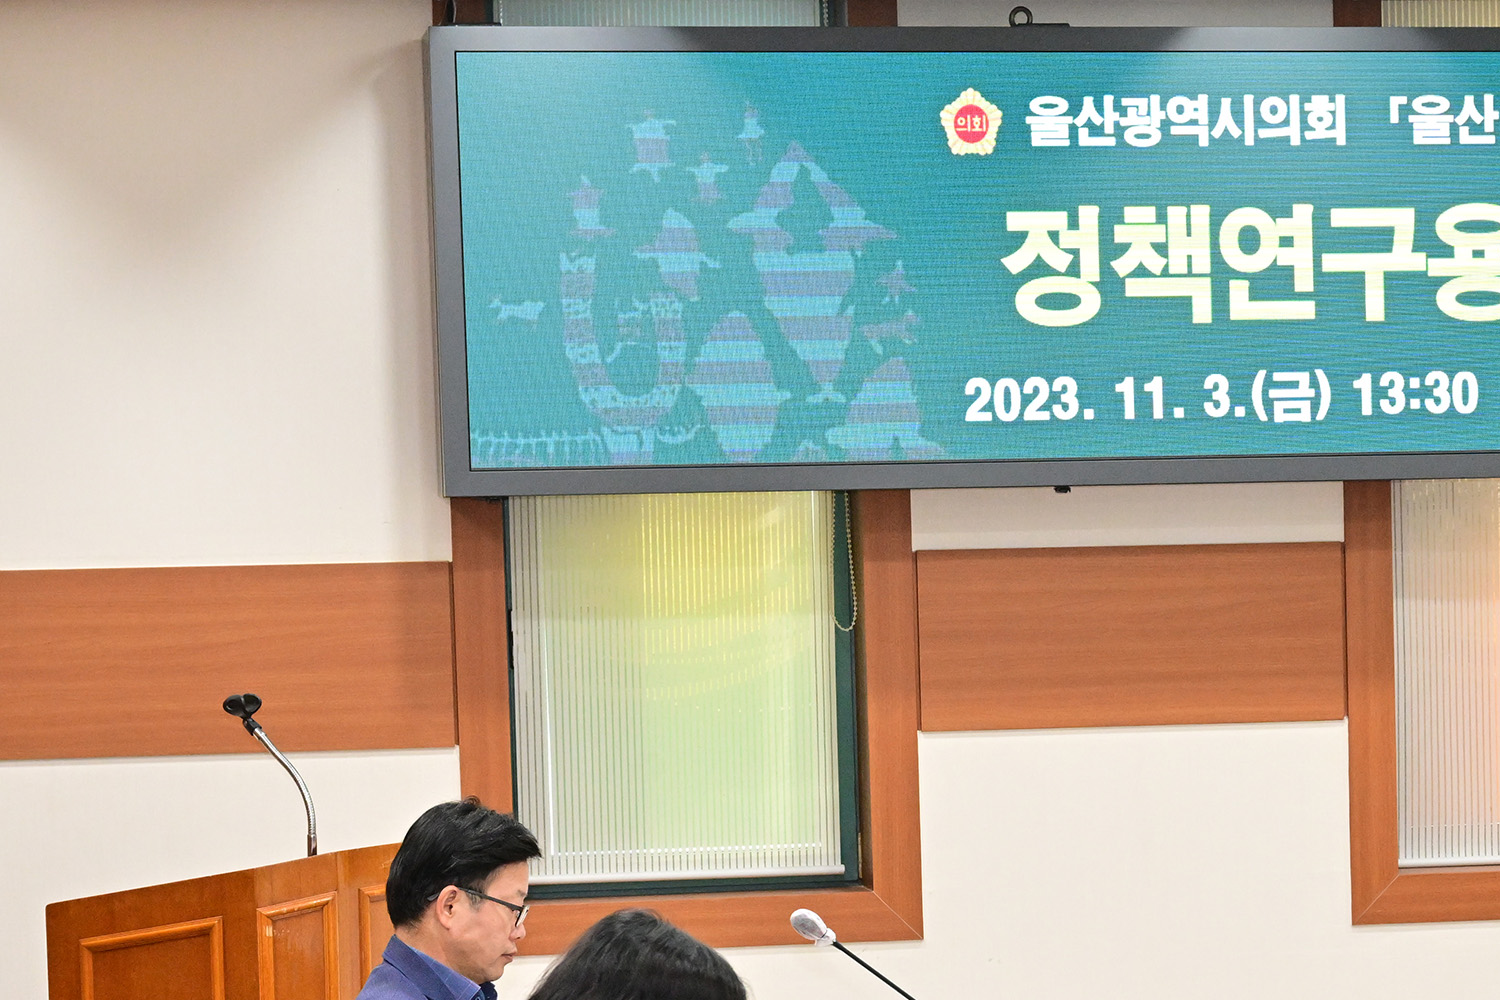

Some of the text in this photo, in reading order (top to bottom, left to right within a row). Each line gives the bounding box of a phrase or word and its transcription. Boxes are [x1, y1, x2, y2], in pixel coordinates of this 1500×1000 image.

[957, 115, 986, 131] 의회
[1026, 94, 1346, 147] 울산광역시의회
[965, 377, 1094, 421] 2023.
[1115, 376, 1184, 419] 11.
[1353, 371, 1478, 415] 13:30
